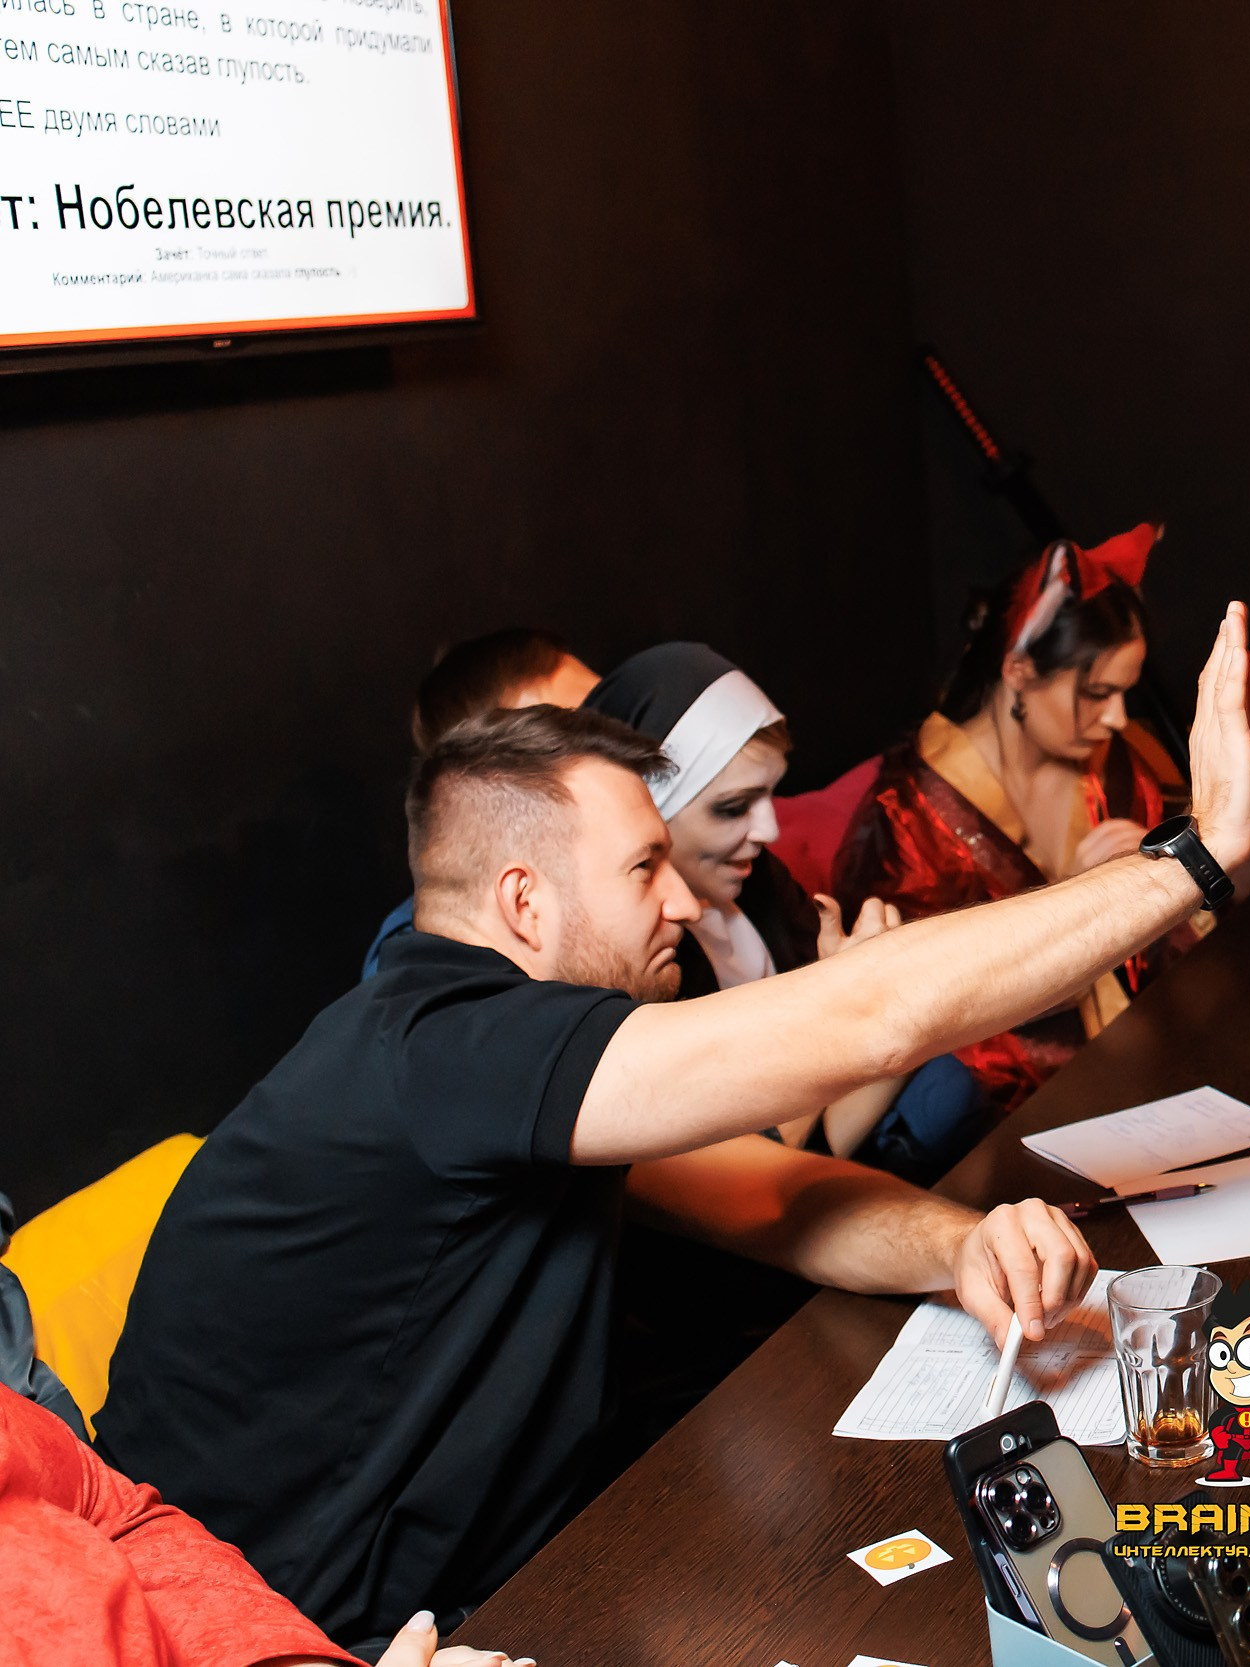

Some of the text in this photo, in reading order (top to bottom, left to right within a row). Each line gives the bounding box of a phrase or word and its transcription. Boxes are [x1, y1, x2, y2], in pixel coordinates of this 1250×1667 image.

[122, 3, 207, 34] стране,
[221, 14, 232, 34] в
[246, 17, 323, 45] которой
[0, 38, 38, 61] ем
[47, 42, 130, 69] самым
[138, 51, 210, 76] сказав
[45, 109, 118, 138] двумя
[126, 114, 221, 137] словами
[55, 184, 313, 230] Нобелевская
[327, 199, 452, 238] премия.
